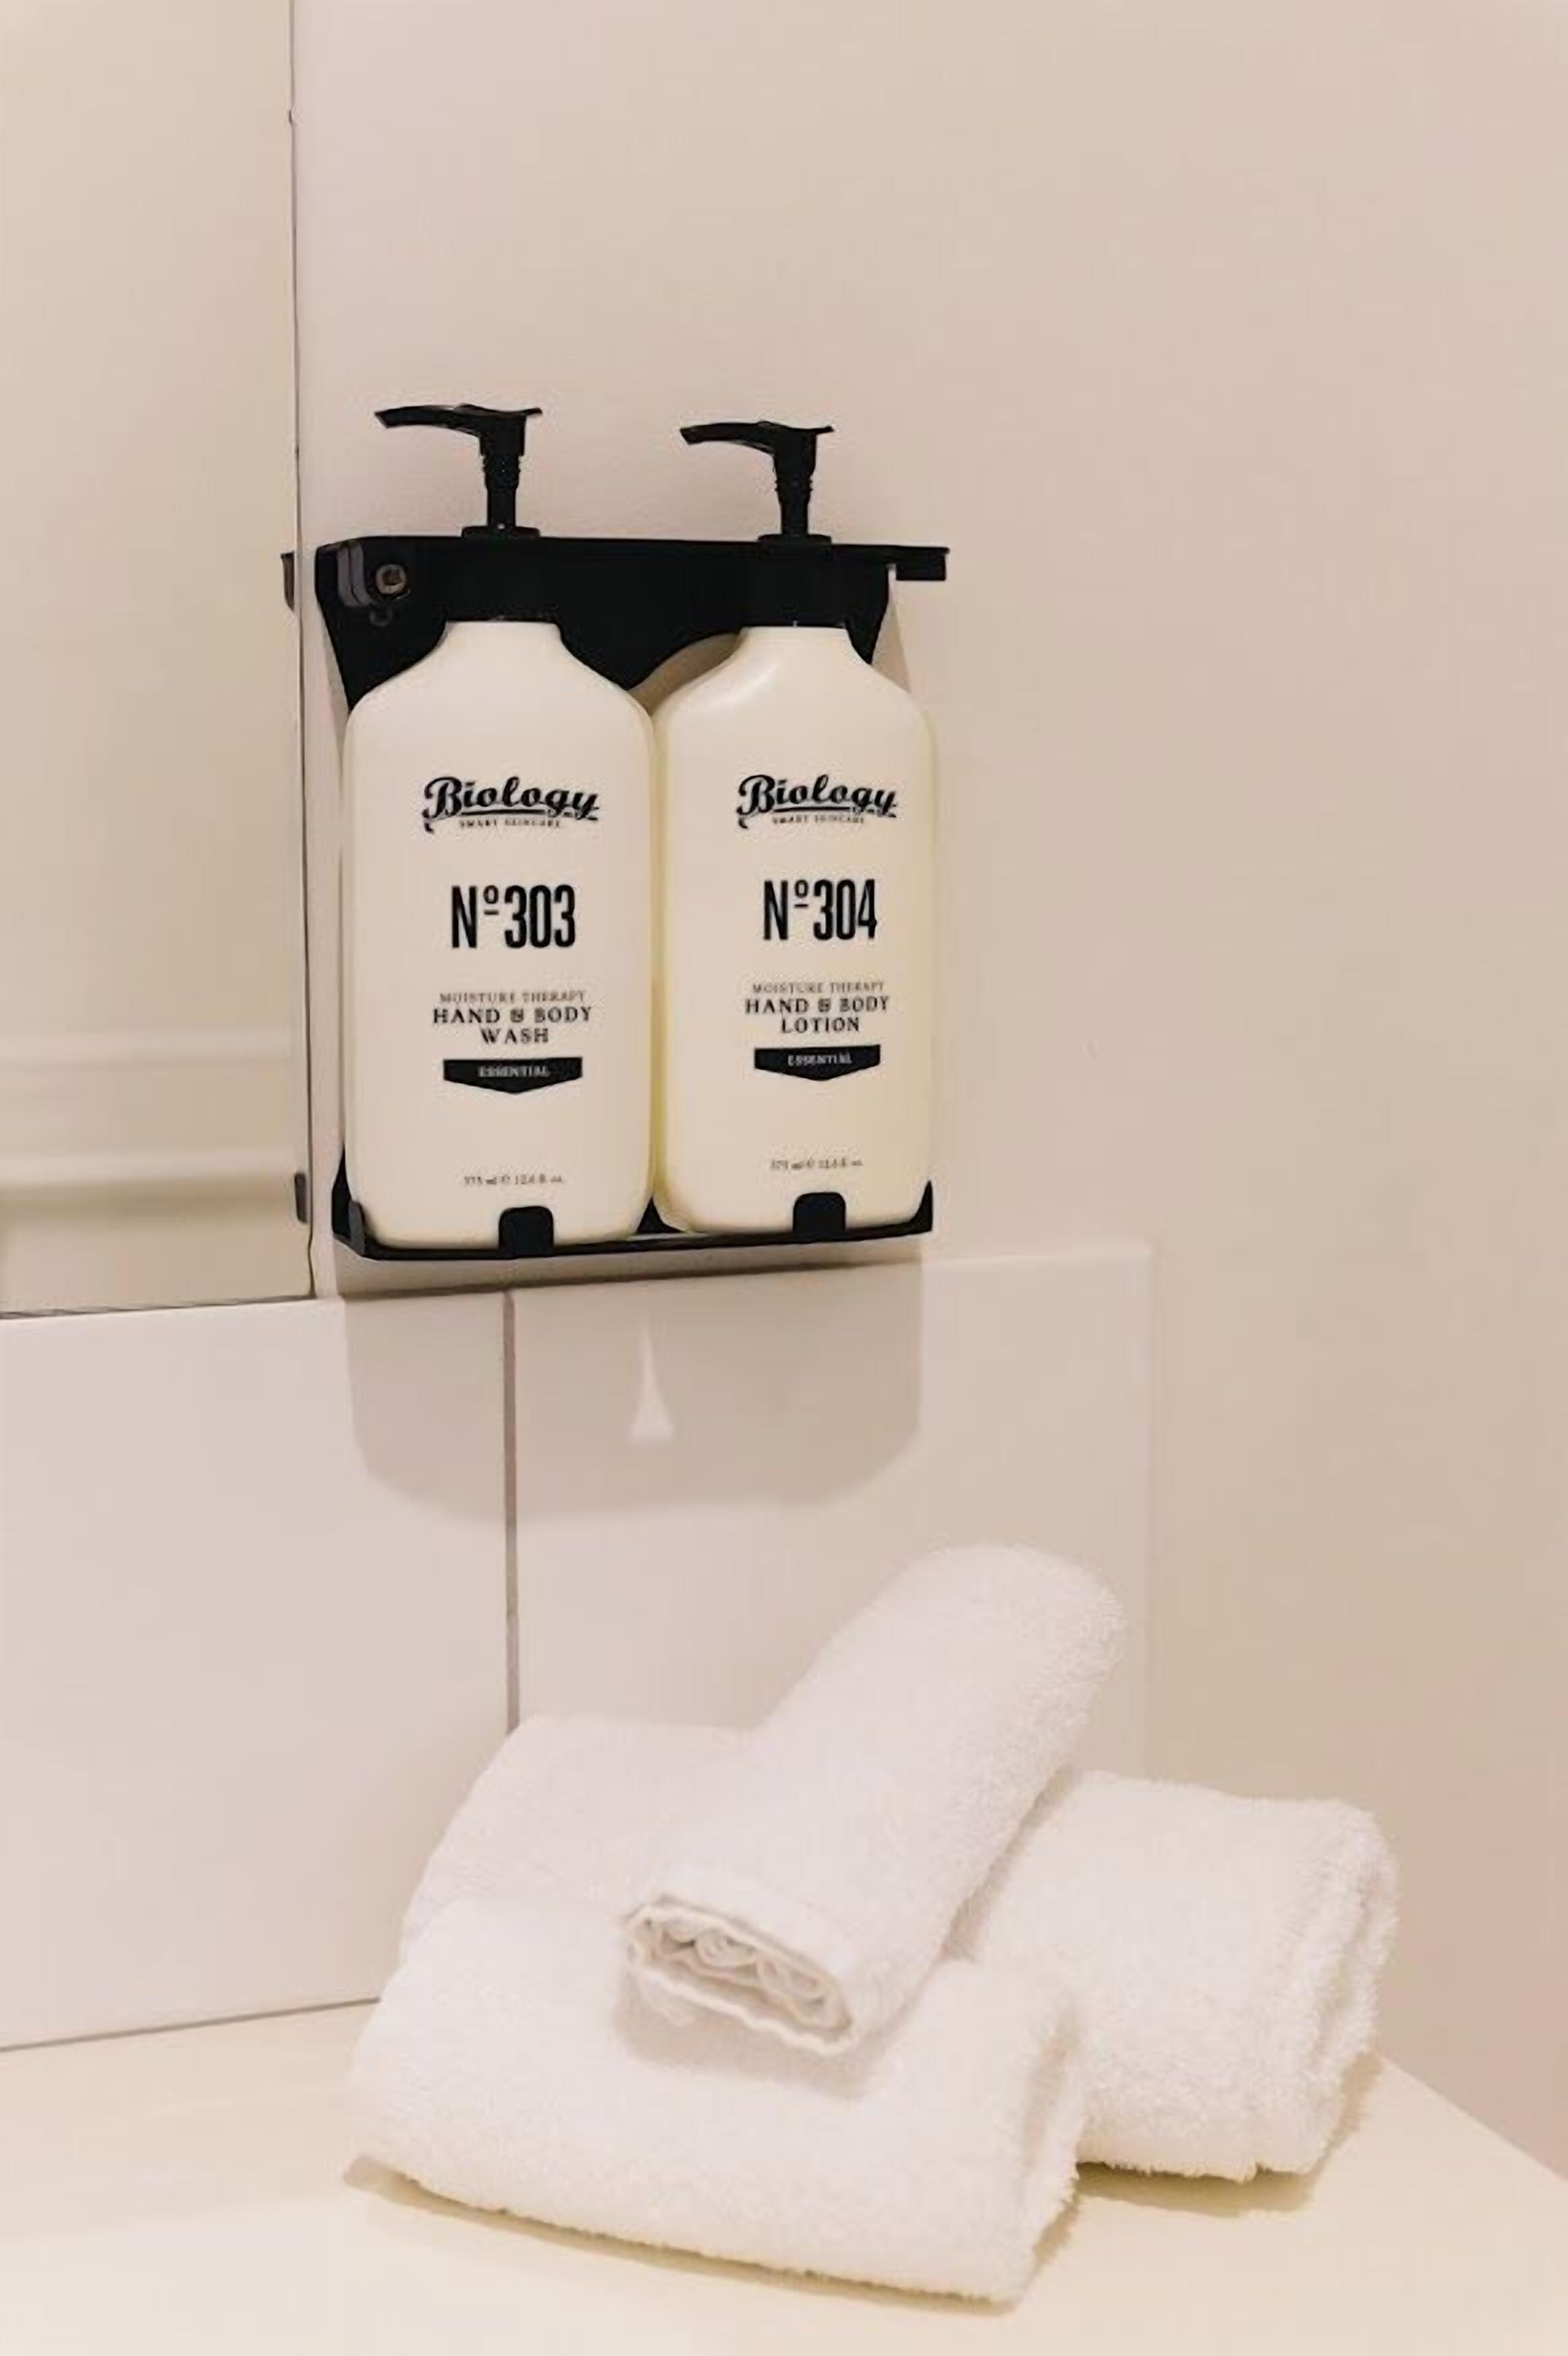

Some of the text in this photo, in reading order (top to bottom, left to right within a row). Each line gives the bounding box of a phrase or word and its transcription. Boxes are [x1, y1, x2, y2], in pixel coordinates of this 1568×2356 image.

[422, 776, 599, 834] Biology
[736, 774, 897, 829] Biology
[752, 980, 885, 994] MOISTURE THERAPY
[439, 990, 586, 1005] MOISTURE THERAPY
[745, 997, 810, 1015] HAND
[839, 995, 891, 1013] BODY
[432, 1007, 501, 1025] HAND
[534, 1005, 592, 1023] BODY
[781, 1015, 860, 1034] LOTION
[480, 1027, 549, 1045] WASH
